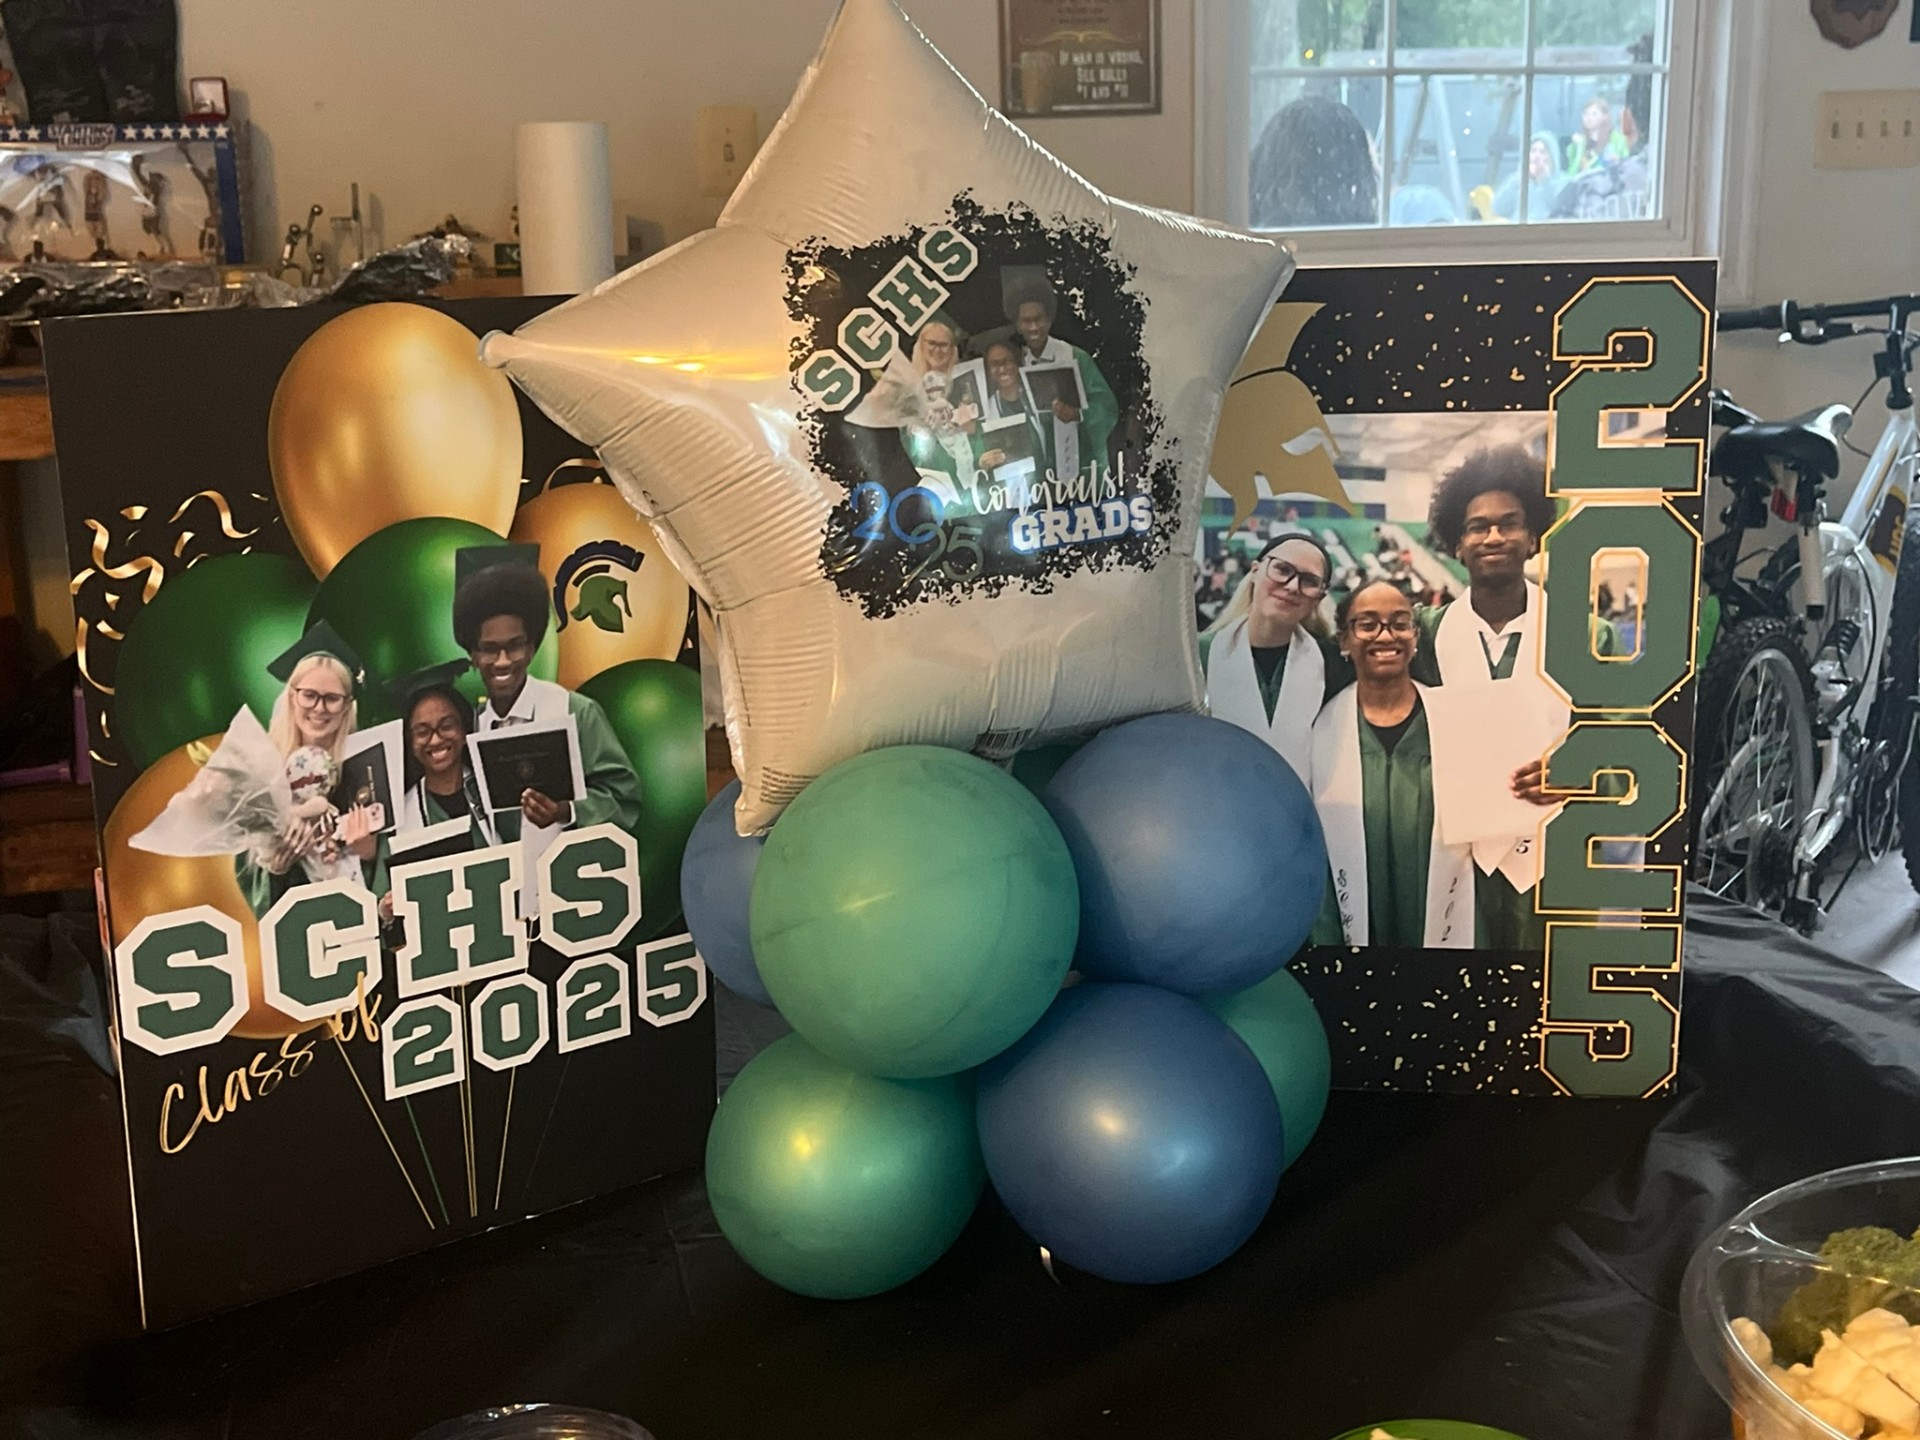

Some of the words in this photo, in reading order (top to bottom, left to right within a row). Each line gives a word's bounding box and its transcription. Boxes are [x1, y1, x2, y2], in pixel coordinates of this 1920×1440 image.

[796, 228, 977, 412] SCHS
[1010, 494, 1153, 554] GRADS
[1536, 277, 1710, 1097] 2025
[115, 822, 642, 1056] SCHS
[159, 1032, 317, 1154] Class
[325, 970, 383, 1042] of
[381, 933, 707, 1101] 2025
